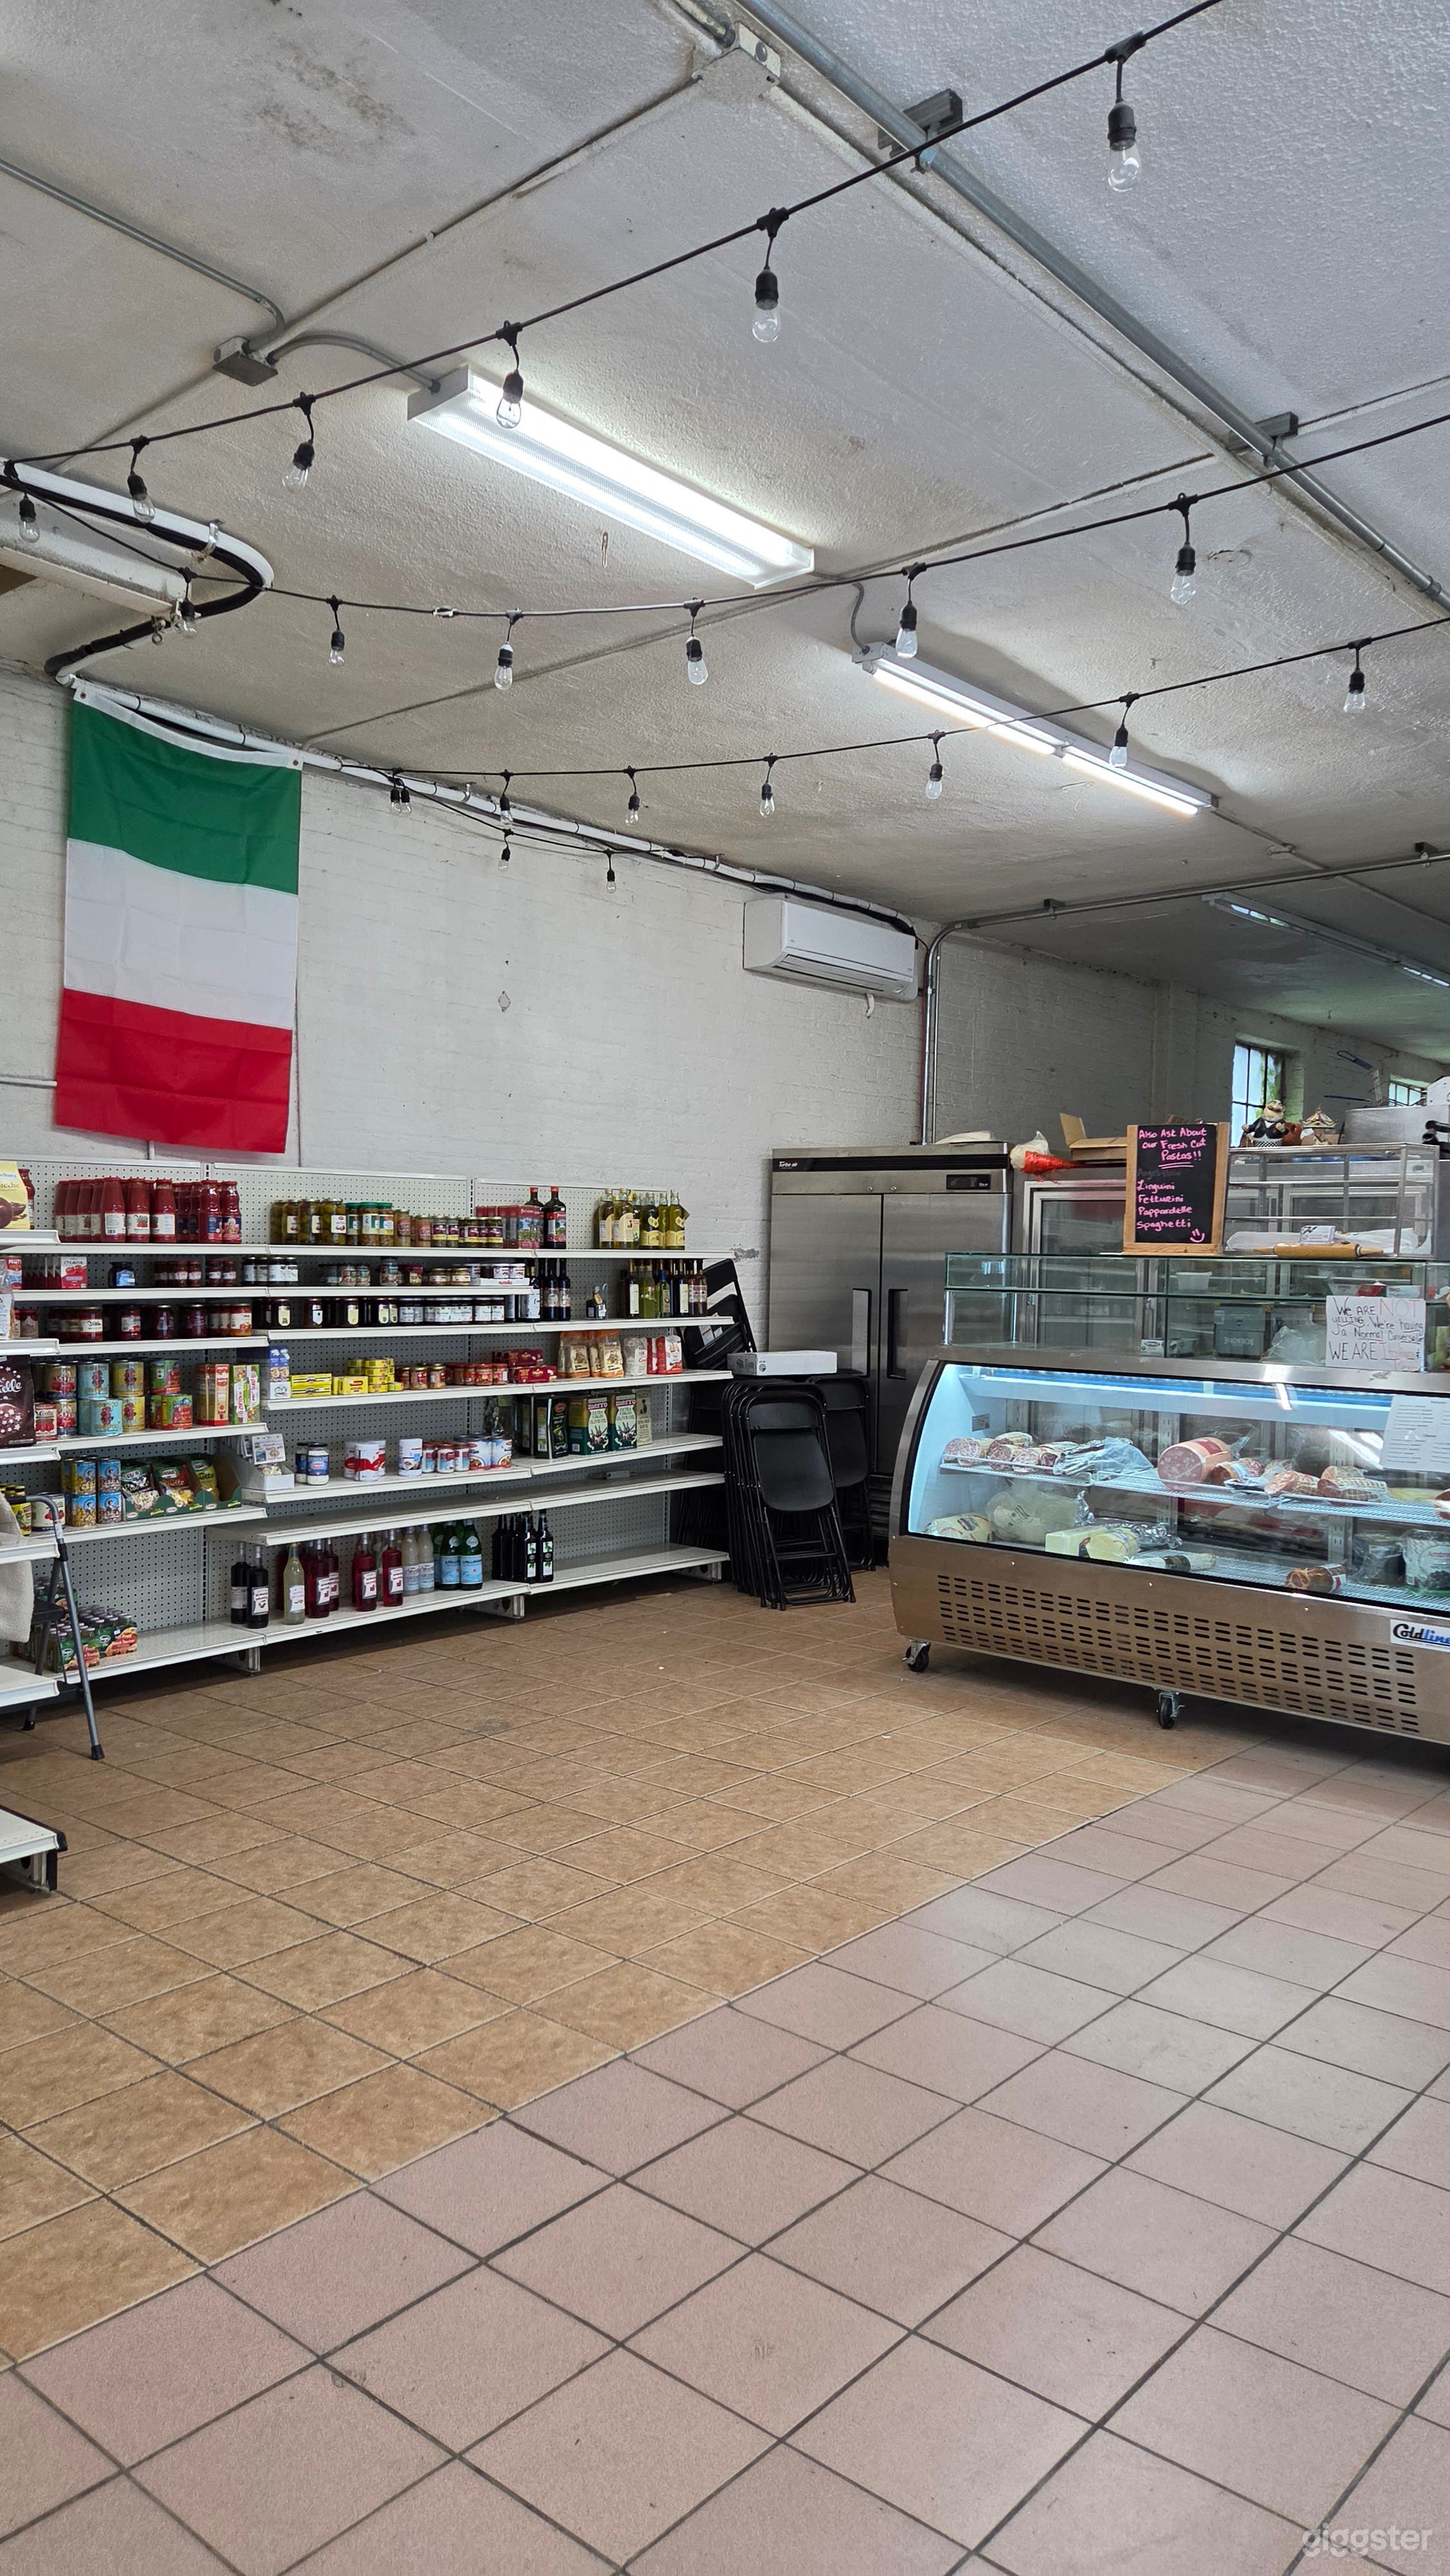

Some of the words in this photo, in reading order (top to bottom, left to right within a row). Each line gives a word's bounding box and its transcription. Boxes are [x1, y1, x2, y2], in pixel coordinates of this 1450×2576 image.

[1139, 1130, 1158, 1139] Also
[1160, 1129, 1177, 1137] Ask
[1180, 1127, 1207, 1137] About
[1160, 1140, 1188, 1150] Fresh
[1136, 1179, 1175, 1194] Linguini
[1136, 1218, 1191, 1232] Spaghetti
[1333, 1297, 1352, 1316] We
[1357, 1305, 1376, 1316] ARE
[1379, 1298, 1421, 1318] NOT
[1341, 1329, 1347, 1337] a
[1328, 1341, 1349, 1361] WE
[1351, 1341, 1378, 1361] ARE
[1393, 1623, 1450, 1645] Coldline
